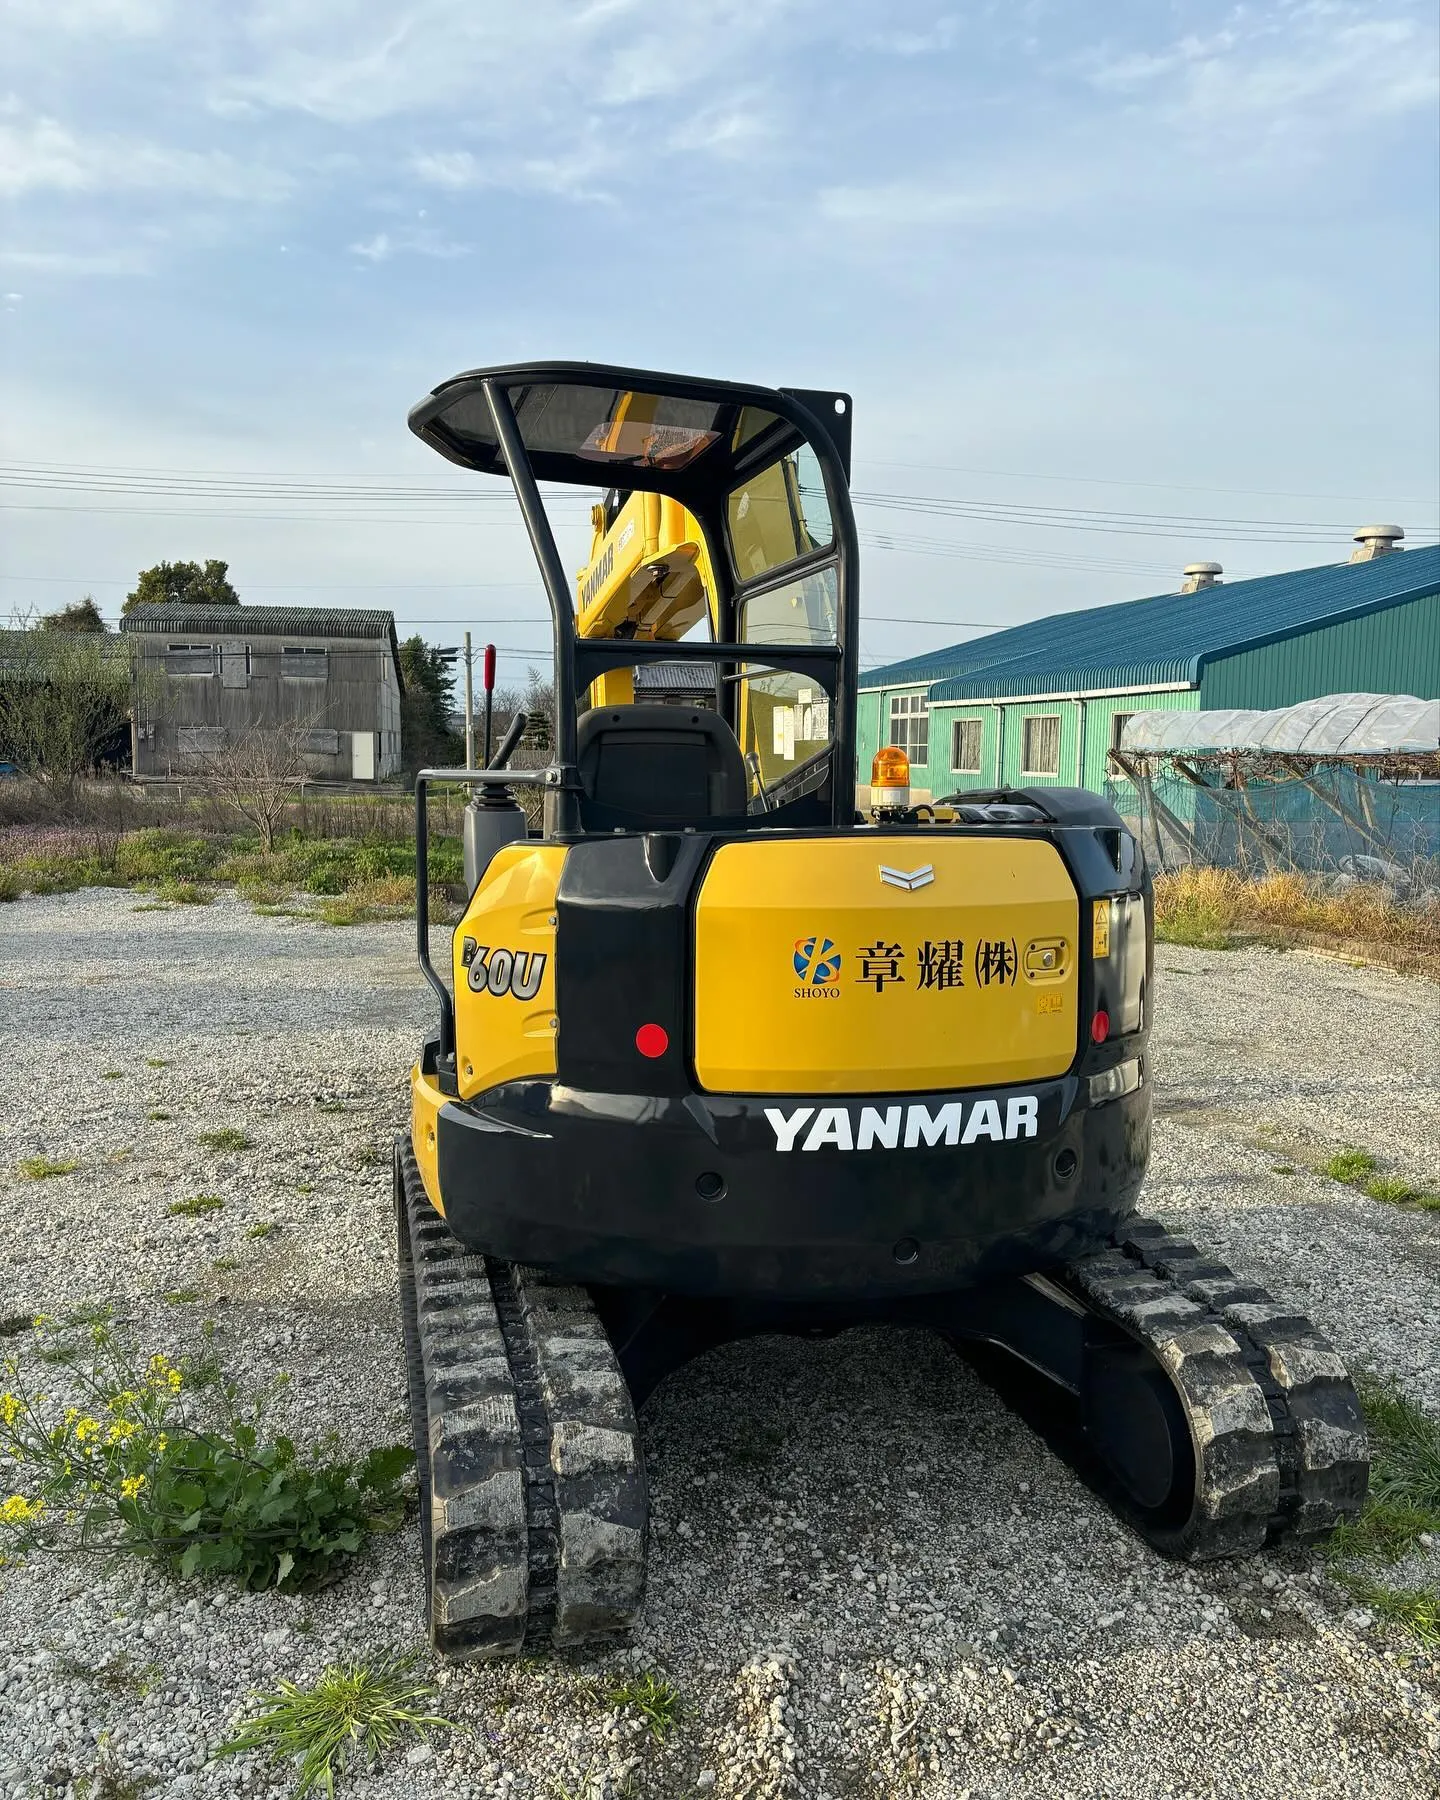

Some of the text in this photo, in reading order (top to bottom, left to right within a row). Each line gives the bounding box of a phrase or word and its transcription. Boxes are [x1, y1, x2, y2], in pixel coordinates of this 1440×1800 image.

[581, 542, 614, 613] YANMAR
[794, 987, 840, 999] SHOYO
[763, 1095, 1038, 1152] YANMAR
